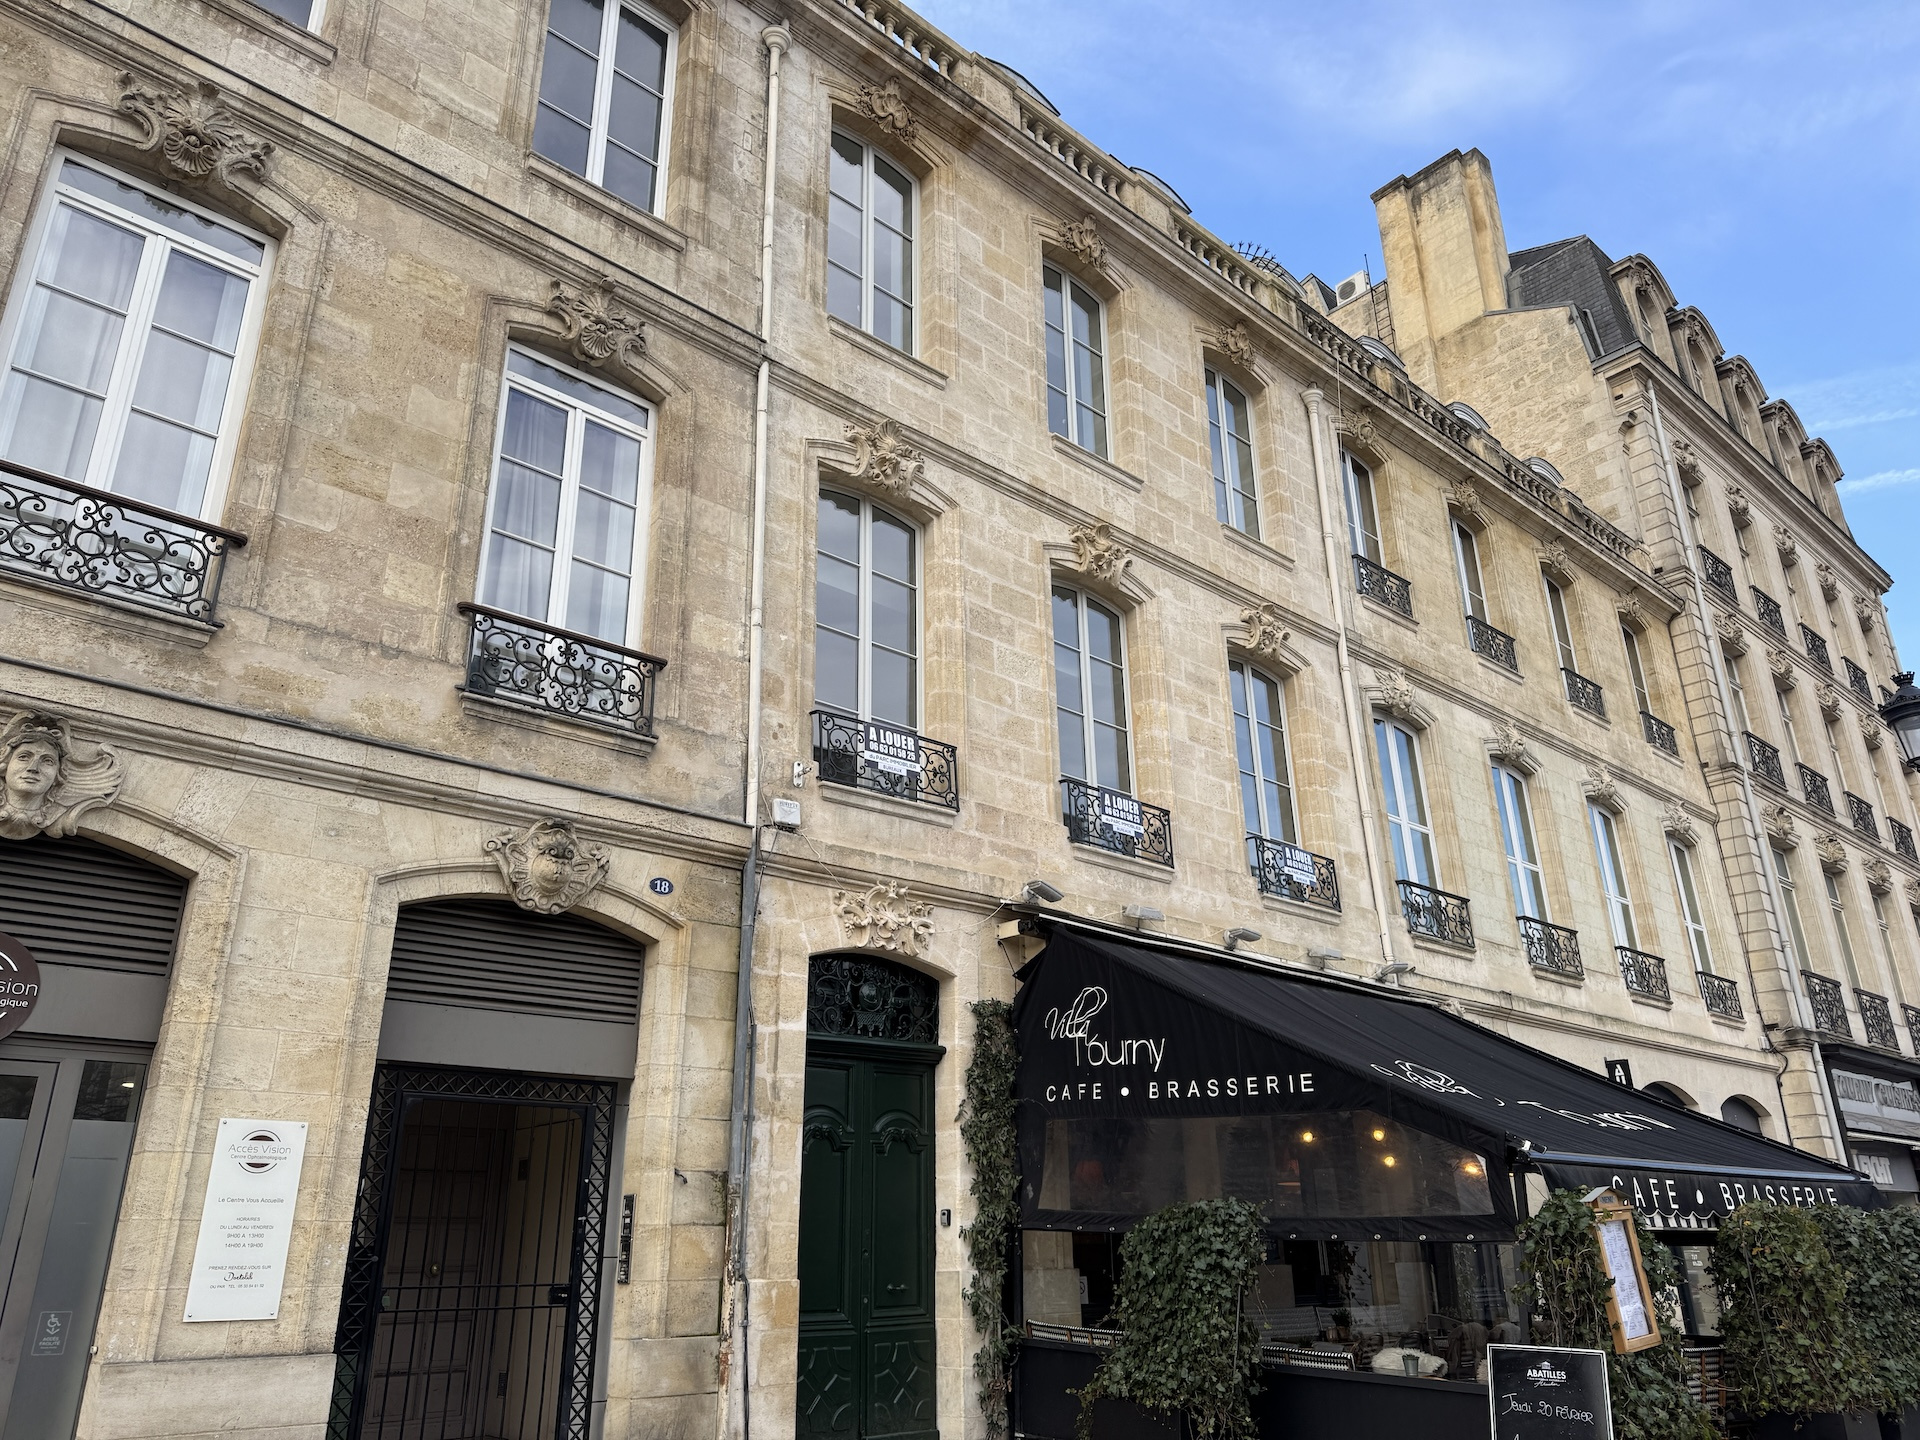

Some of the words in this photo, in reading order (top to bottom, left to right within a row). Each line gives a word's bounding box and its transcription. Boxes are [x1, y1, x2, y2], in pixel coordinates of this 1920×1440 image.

[870, 726, 878, 741] A
[880, 729, 915, 751] LOUER
[870, 741, 879, 751] 06
[1105, 793, 1111, 807] A
[1112, 795, 1140, 815] LOUER
[1285, 847, 1292, 859] A
[1292, 849, 1313, 866] LOUER
[654, 880, 669, 893] 18
[1067, 1033, 1166, 1072] Tourny
[1046, 1083, 1102, 1102] CAFE
[1149, 1073, 1315, 1099] BRASSERIE
[228, 1143, 259, 1154] Accès
[261, 1144, 292, 1155] Vision
[1526, 1369, 1567, 1380] ABATILLES
[1502, 1393, 1533, 1416] Jeudi
[1537, 1401, 1553, 1417] 20
